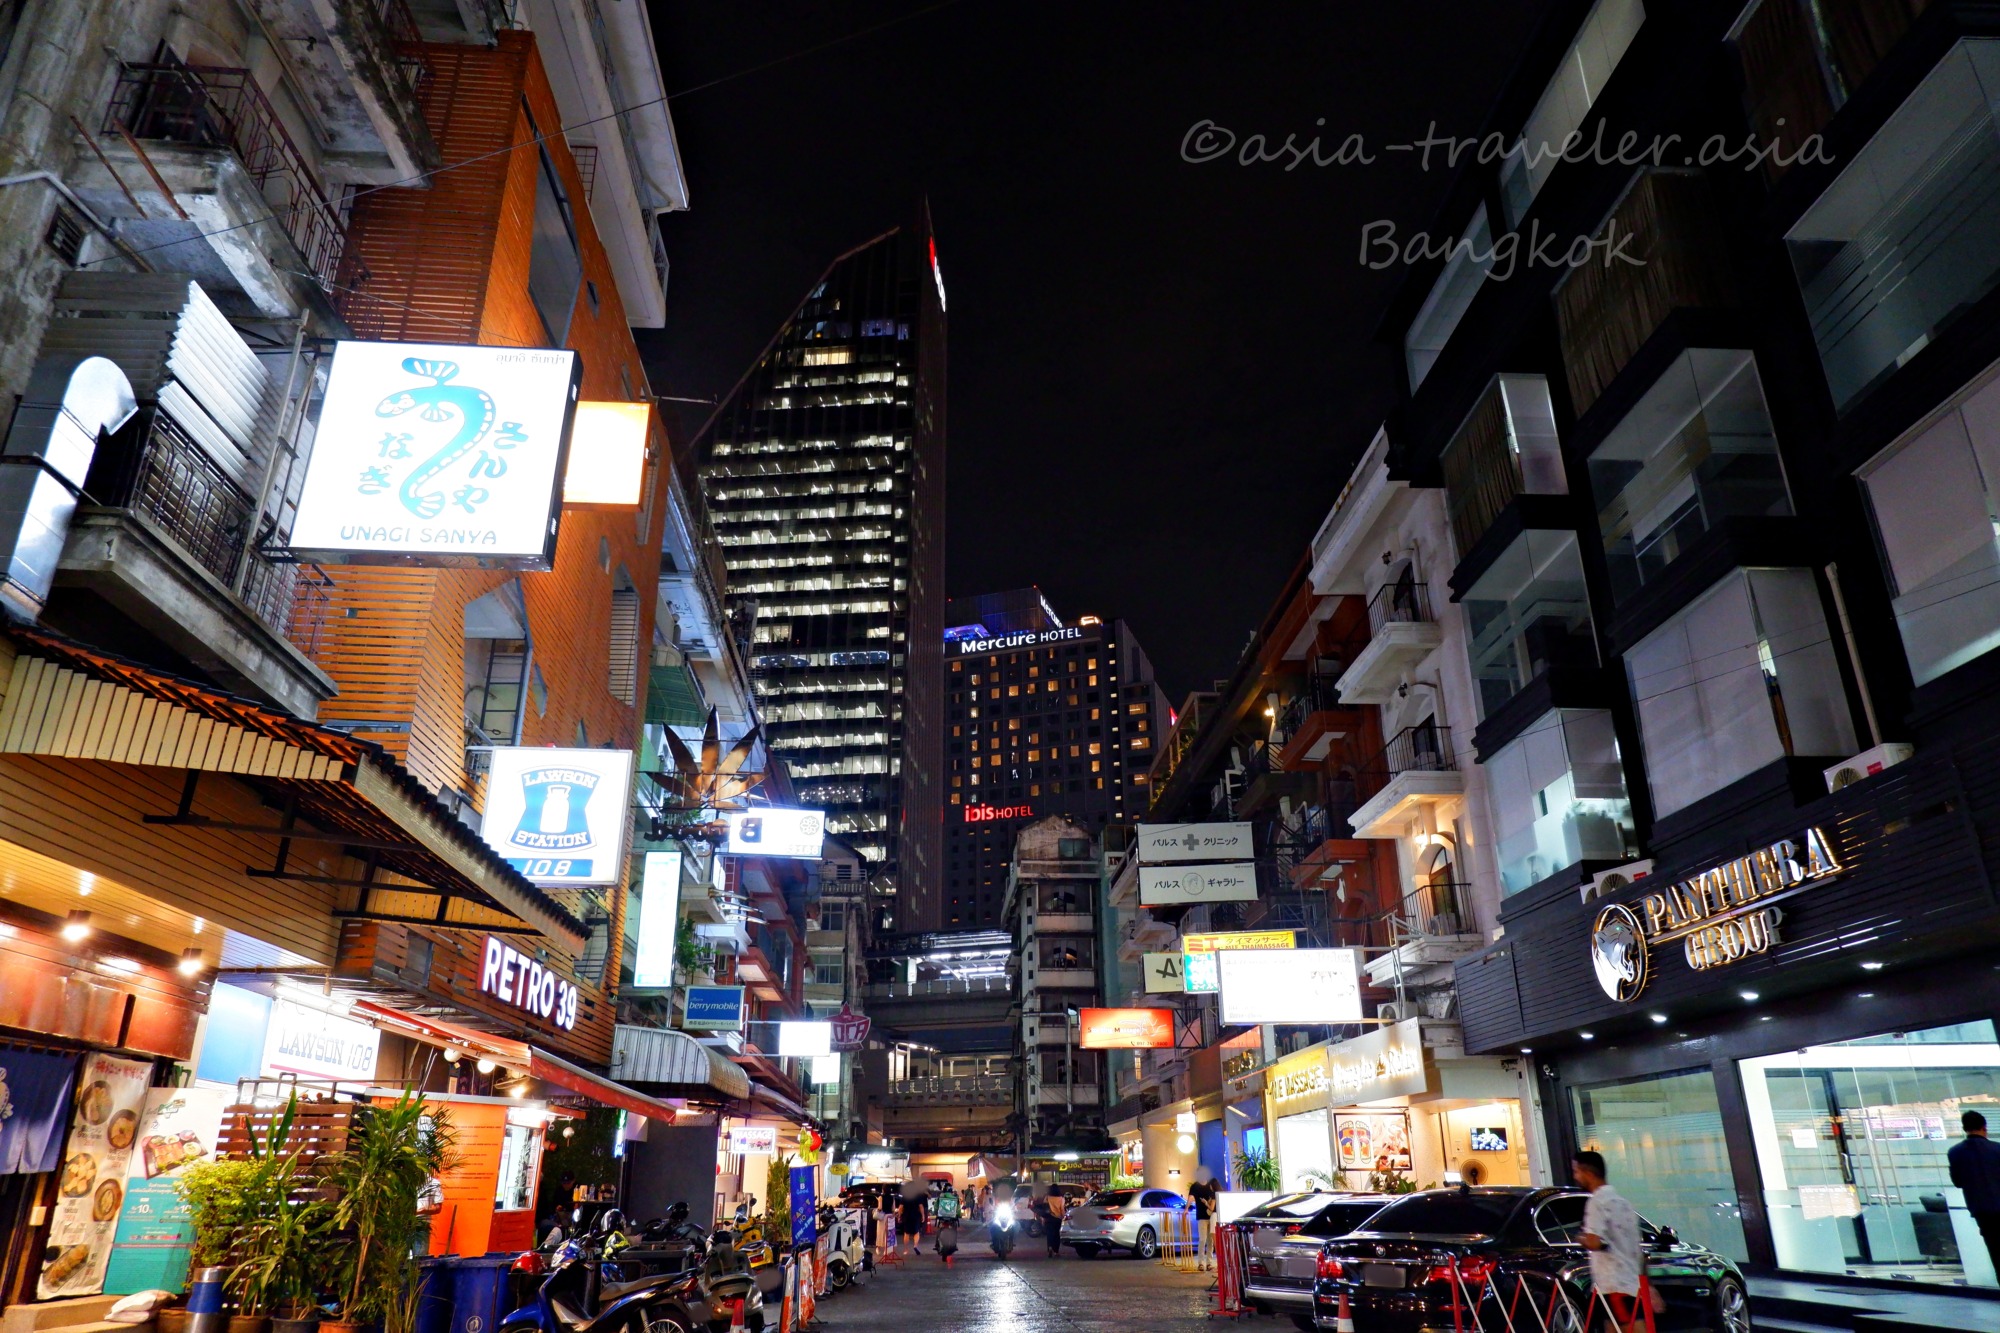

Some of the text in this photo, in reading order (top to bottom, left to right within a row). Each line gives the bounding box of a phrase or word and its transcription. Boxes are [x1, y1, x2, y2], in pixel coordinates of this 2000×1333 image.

[340, 525, 497, 545] UNAGI SANYA
[961, 627, 1082, 653] Mercure HOTEL
[523, 769, 598, 789] LAWSON
[965, 803, 1034, 822] ibis HOTEL
[515, 830, 588, 848] STATION
[1203, 837, 1239, 846] クリニック
[523, 859, 573, 876] 108
[1207, 877, 1245, 887] ギャラリー
[1641, 827, 1842, 937] PANTHERA
[1684, 905, 1785, 971] GROUP
[482, 936, 577, 1031] RETRO 39
[689, 1001, 739, 1011] berry mobile
[278, 1028, 373, 1071] LAWSON 108
[735, 1130, 772, 1140] MASSAGE
